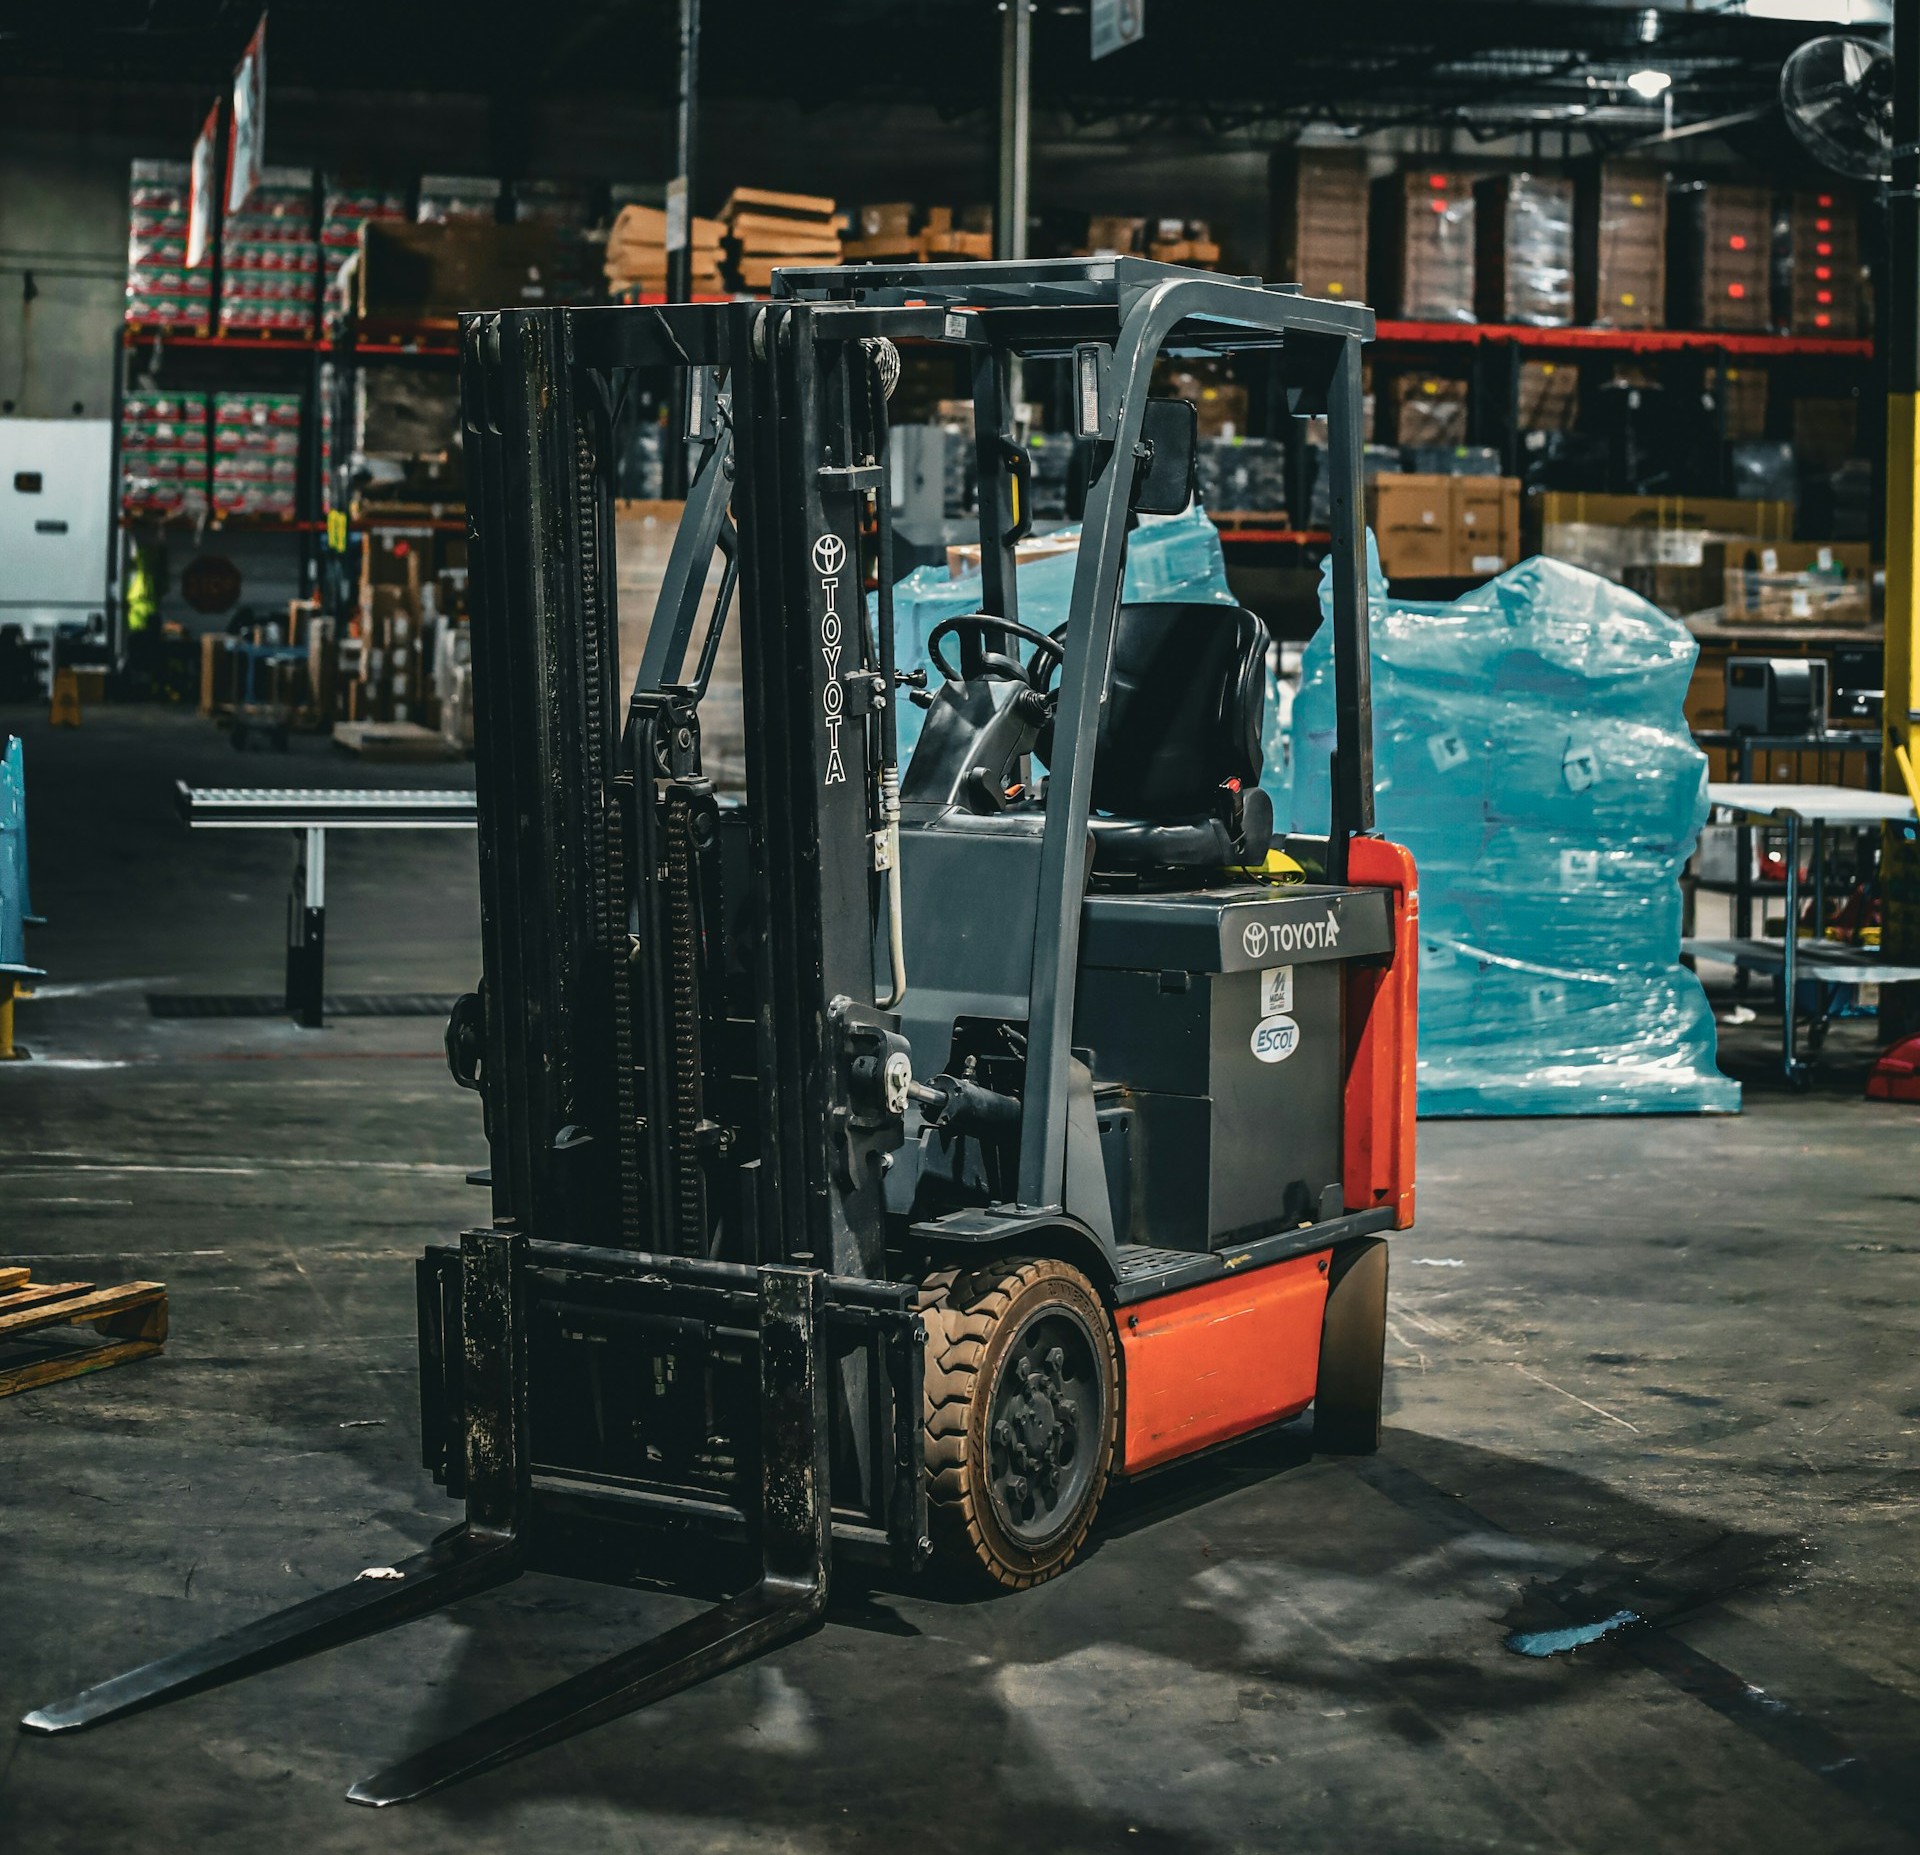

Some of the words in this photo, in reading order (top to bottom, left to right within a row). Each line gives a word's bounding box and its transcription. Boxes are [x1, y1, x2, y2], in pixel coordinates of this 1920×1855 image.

[822, 577, 846, 785] TOYOTA
[1270, 921, 1338, 952] TOYOTA
[1256, 1024, 1295, 1053] ESCOL
